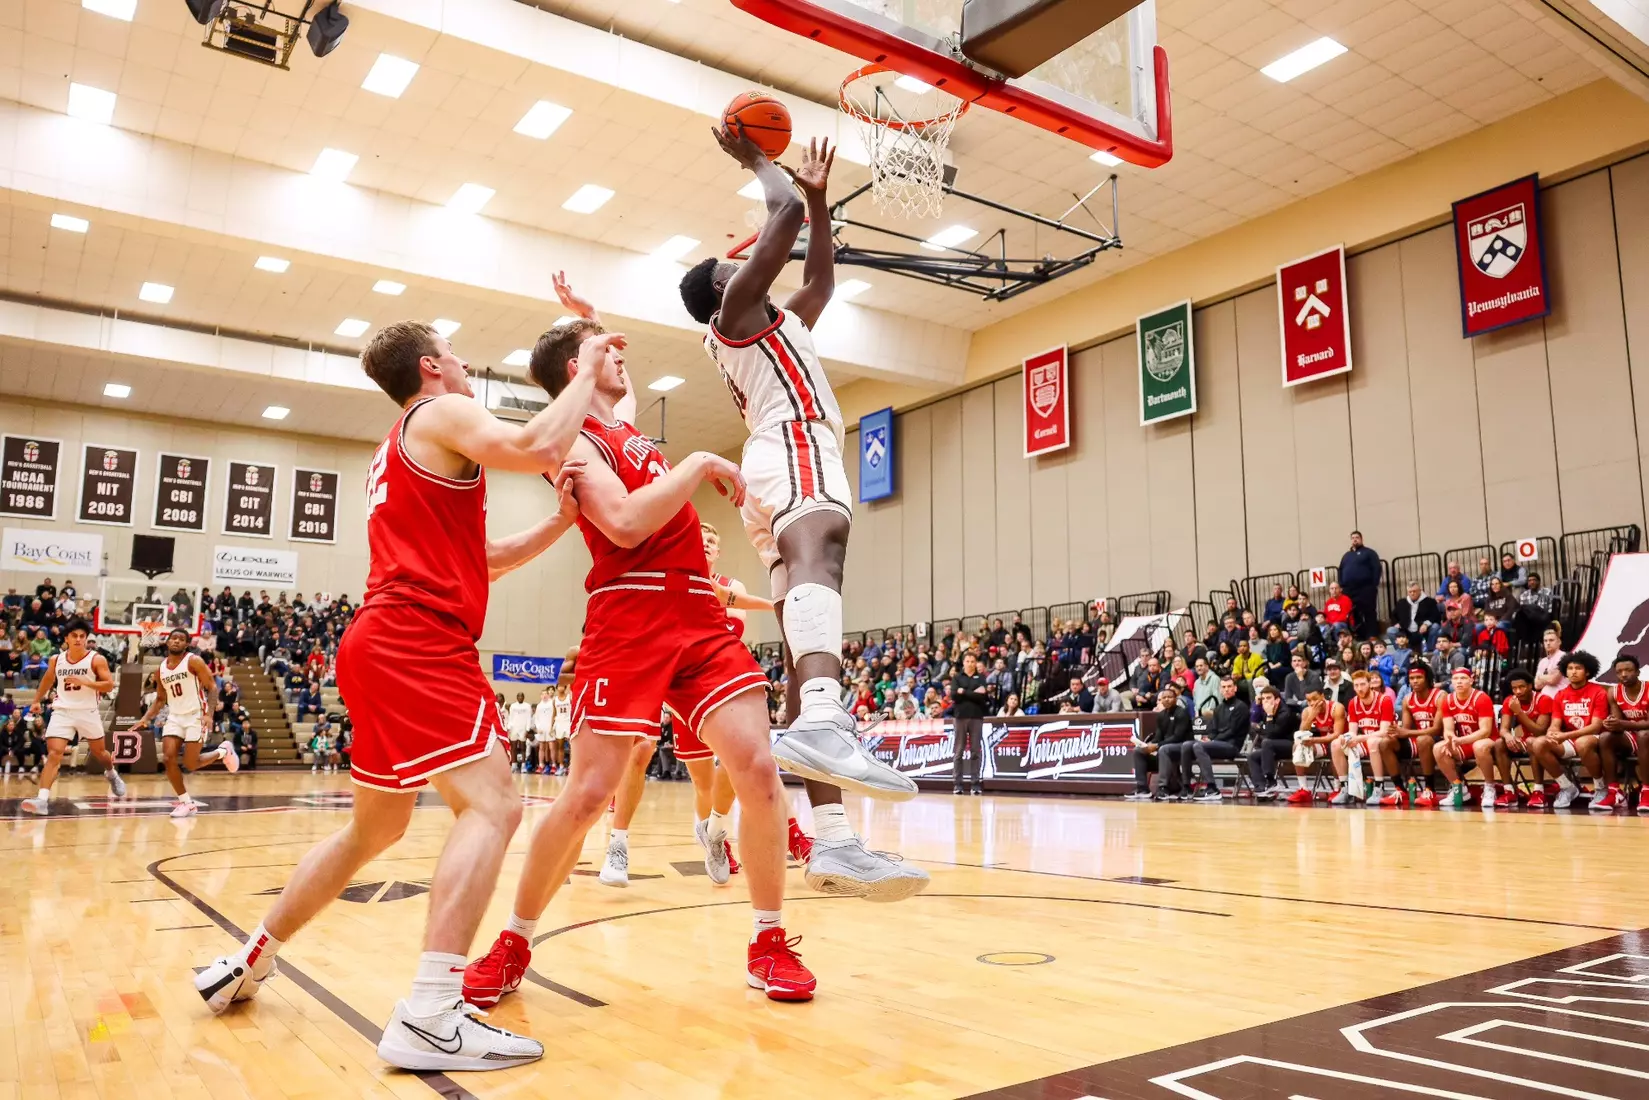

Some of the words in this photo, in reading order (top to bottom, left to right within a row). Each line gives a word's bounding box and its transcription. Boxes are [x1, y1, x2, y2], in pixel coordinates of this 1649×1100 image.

[1467, 285, 1540, 317] Pennsylvania
[1296, 346, 1334, 368] Harvard
[1147, 386, 1187, 406] Dartmouth
[12, 470, 45, 483] NCAA
[2, 480, 54, 492] TOURNAMENT
[97, 482, 119, 496] NIT
[9, 494, 45, 509] 1986
[170, 489, 193, 503] CBI
[239, 496, 261, 509] CIT
[88, 501, 124, 516] 2003
[162, 508, 197, 523] 2008
[304, 502, 325, 516] CBI
[232, 514, 264, 529] 2014
[14, 541, 92, 561] BayCoast
[1520, 542, 1535, 557] O
[234, 555, 278, 564] LEXUS
[215, 567, 241, 575] LEXUS
[255, 570, 294, 579] WARWICK
[1312, 572, 1323, 583] N
[57, 668, 88, 676] BROWN
[501, 658, 555, 675] BayCoast
[170, 682, 183, 698] 10
[594, 677, 609, 707] C
[113, 731, 142, 763] B
[674, 733, 680, 749] C
[997, 746, 1021, 757] SINCE
[1020, 720, 1104, 773] Narragansett
[1105, 746, 1128, 756] 1890
